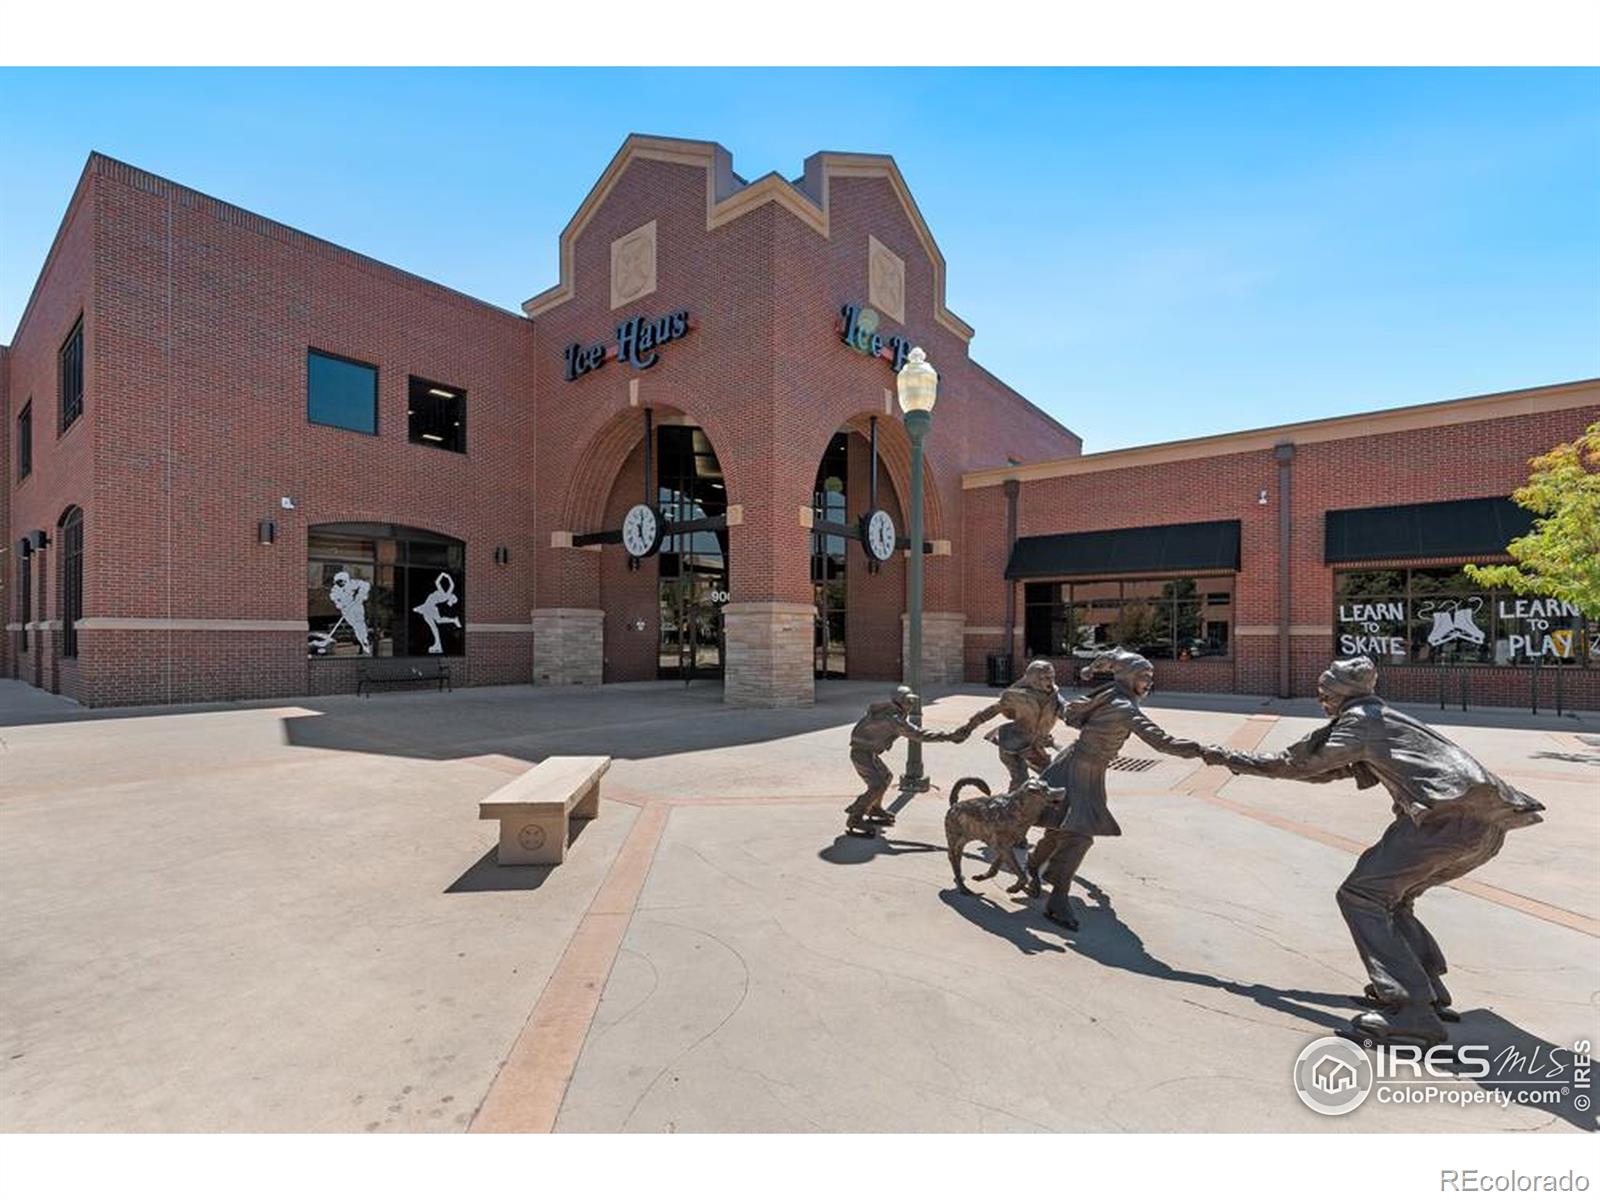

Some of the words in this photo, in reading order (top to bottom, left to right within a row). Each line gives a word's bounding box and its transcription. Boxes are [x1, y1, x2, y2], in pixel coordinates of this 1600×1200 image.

[841, 303, 883, 358] Ice
[565, 341, 606, 382] Ice
[615, 308, 690, 369] Haus
[711, 591, 730, 603] 90
[1339, 602, 1404, 623] LEARN
[1500, 599, 1580, 619] LEARN
[1361, 621, 1379, 633] TO
[1526, 618, 1549, 632] TO
[1340, 635, 1407, 656] SKATE
[1510, 633, 1574, 658] PLAY
